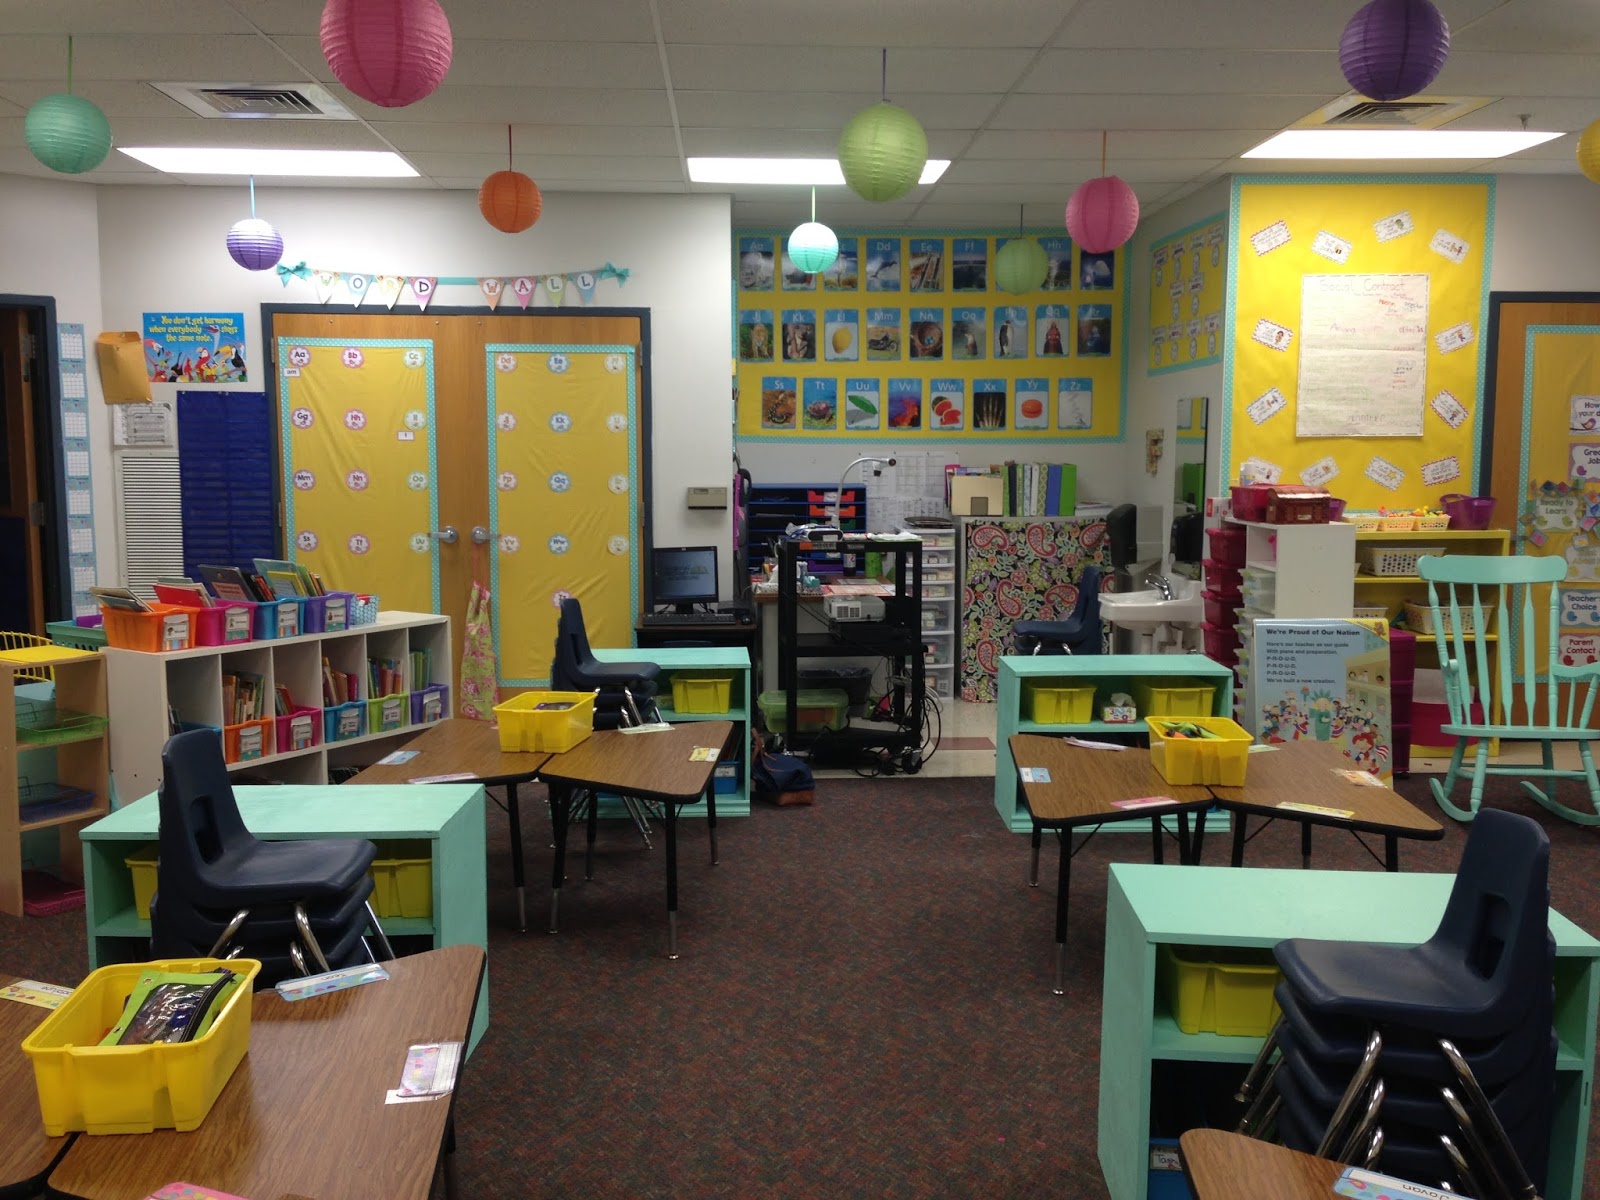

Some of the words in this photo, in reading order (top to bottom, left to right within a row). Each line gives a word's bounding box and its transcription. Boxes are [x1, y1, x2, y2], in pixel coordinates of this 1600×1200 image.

[876, 242, 891, 251] Dd
[921, 242, 933, 252] Ee
[964, 242, 975, 251] Ff
[1047, 241, 1062, 249] Hh
[485, 275, 591, 293] WALL
[1364, 278, 1405, 291] Contract
[173, 315, 191, 324] don't
[191, 316, 203, 325] get
[204, 316, 234, 325] harmony
[792, 313, 805, 322] Kk
[874, 312, 894, 321] Mm
[920, 312, 933, 320] Nn
[961, 312, 976, 320] Oo
[149, 325, 166, 333] when
[167, 325, 202, 334] everybody
[220, 325, 238, 334] sings
[166, 334, 177, 342] the
[348, 351, 358, 359] Bb
[408, 352, 419, 360] Cc
[554, 357, 563, 365] Ee
[774, 380, 785, 389] Ss
[815, 381, 826, 390] Tt
[855, 382, 870, 390] Uu
[900, 382, 912, 391] Vv
[937, 382, 957, 391] Ww
[984, 382, 997, 391] Xx
[1026, 380, 1039, 389] Yy
[1070, 382, 1081, 390] Zz
[296, 412, 309, 421] Gg
[412, 475, 424, 483] Oo
[554, 476, 566, 485] Qq
[1545, 507, 1567, 515] Learn
[1571, 603, 1597, 611] Choice
